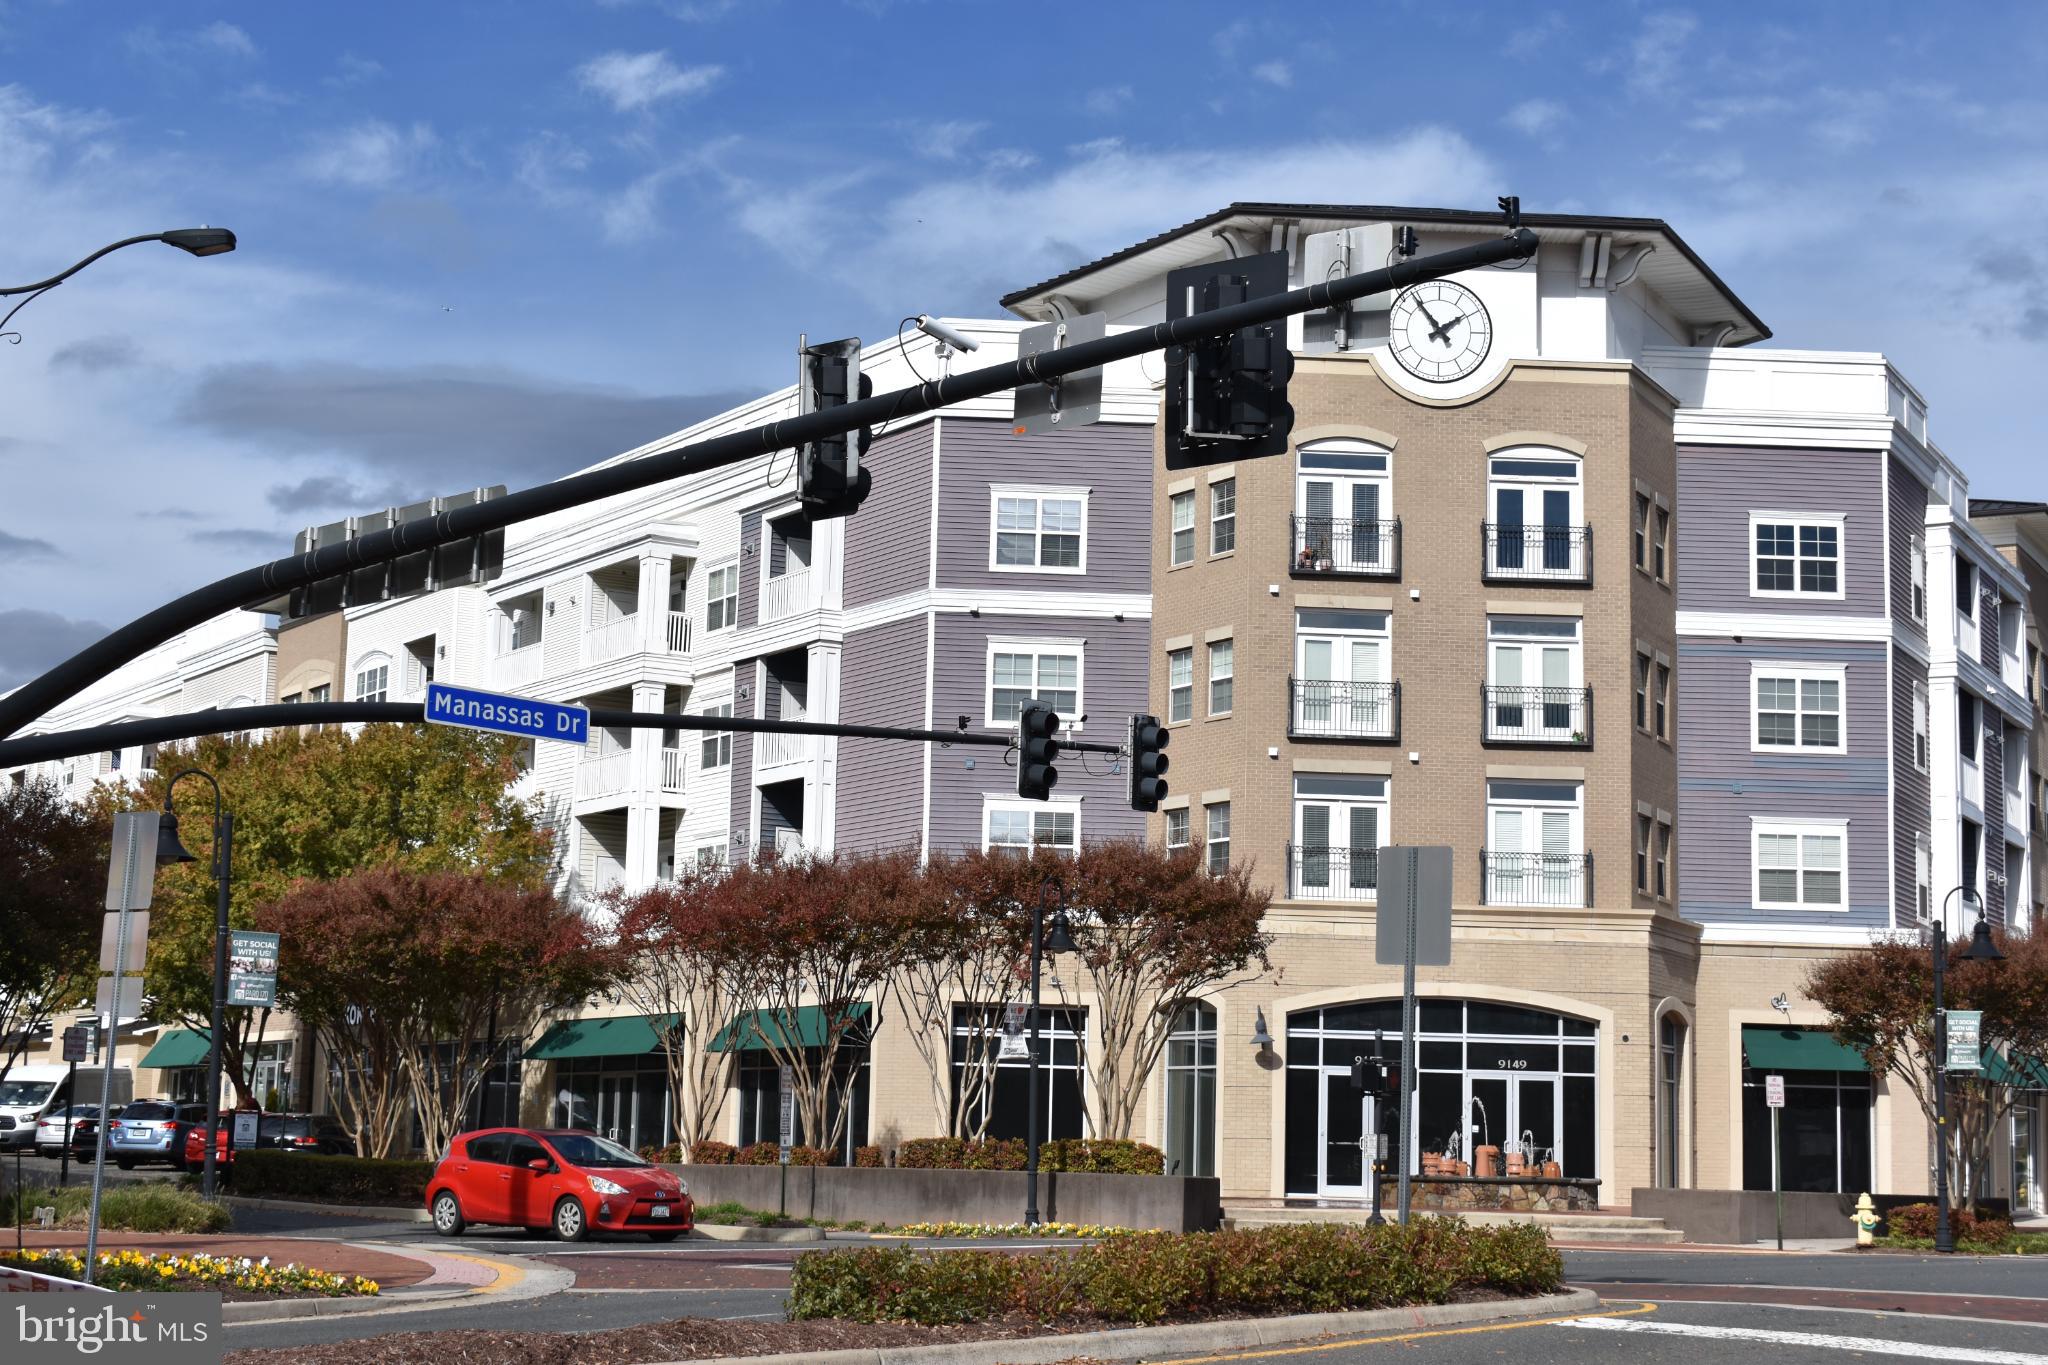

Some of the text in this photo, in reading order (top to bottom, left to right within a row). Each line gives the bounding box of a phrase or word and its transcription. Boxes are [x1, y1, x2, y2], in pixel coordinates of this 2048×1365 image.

[435, 692, 581, 734] Manassas Dr
[250, 941, 277, 949] SOCIAL
[238, 948, 257, 956] WITH
[1498, 1059, 1527, 1069] 9149
